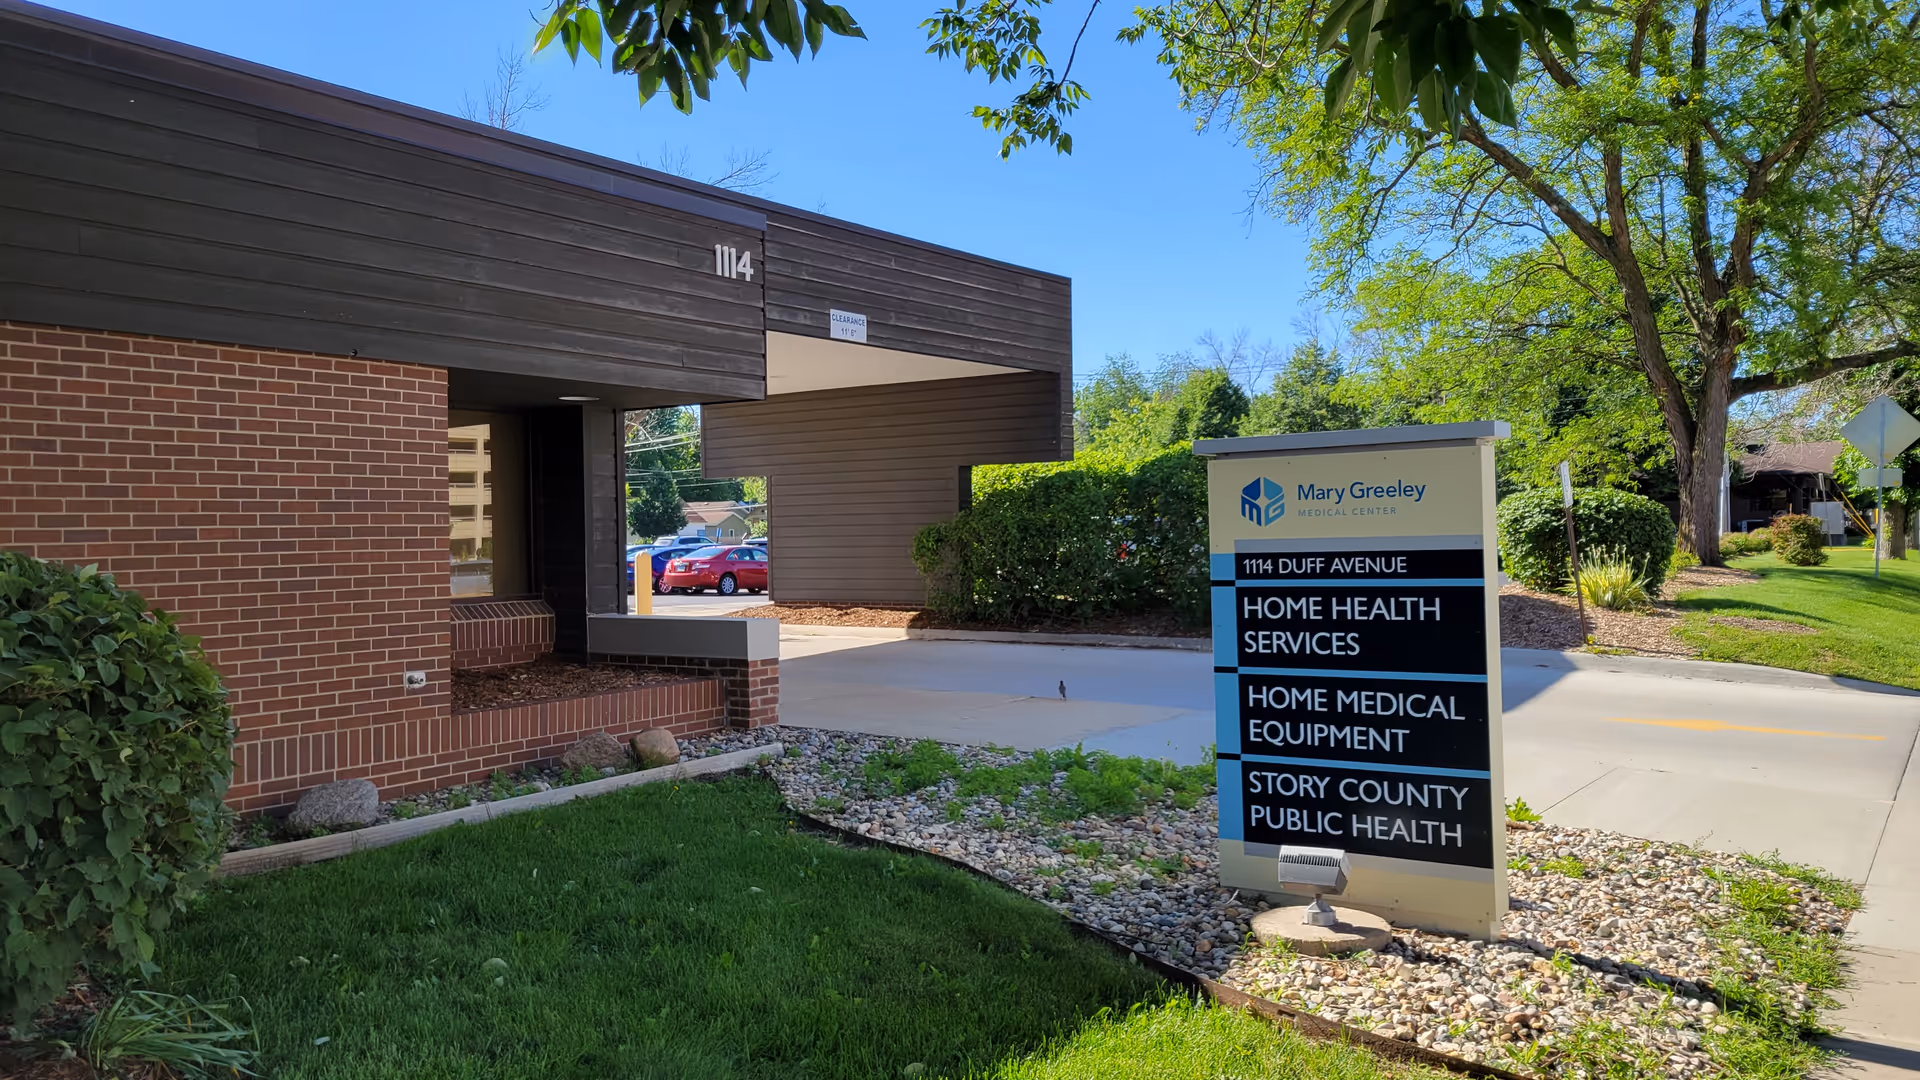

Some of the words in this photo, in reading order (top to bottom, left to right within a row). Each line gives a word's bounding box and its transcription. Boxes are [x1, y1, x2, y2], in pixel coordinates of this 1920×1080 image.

[715, 244, 753, 281] 1114
[831, 313, 866, 327] CLEARANCE
[1297, 483, 1346, 504] Mary
[1350, 479, 1427, 502] Greeley
[1297, 508, 1348, 517] MEDICAL
[1351, 506, 1397, 516] CENTER
[1243, 558, 1273, 574] 1114
[1278, 557, 1325, 574] DUFF
[1330, 556, 1408, 573] AVENUE
[1243, 597, 1323, 620] HOME
[1331, 597, 1441, 621] HEALTH
[1244, 631, 1360, 656] SERVICES
[1248, 686, 1328, 712] HOME
[1336, 690, 1466, 720] MEDICAL
[1249, 719, 1410, 752] EQUIPMENT
[1249, 771, 1331, 799] STORY
[1338, 778, 1469, 811] COUNTY
[1250, 804, 1343, 836] PUBLIC
[1351, 813, 1463, 848] HEALTH
